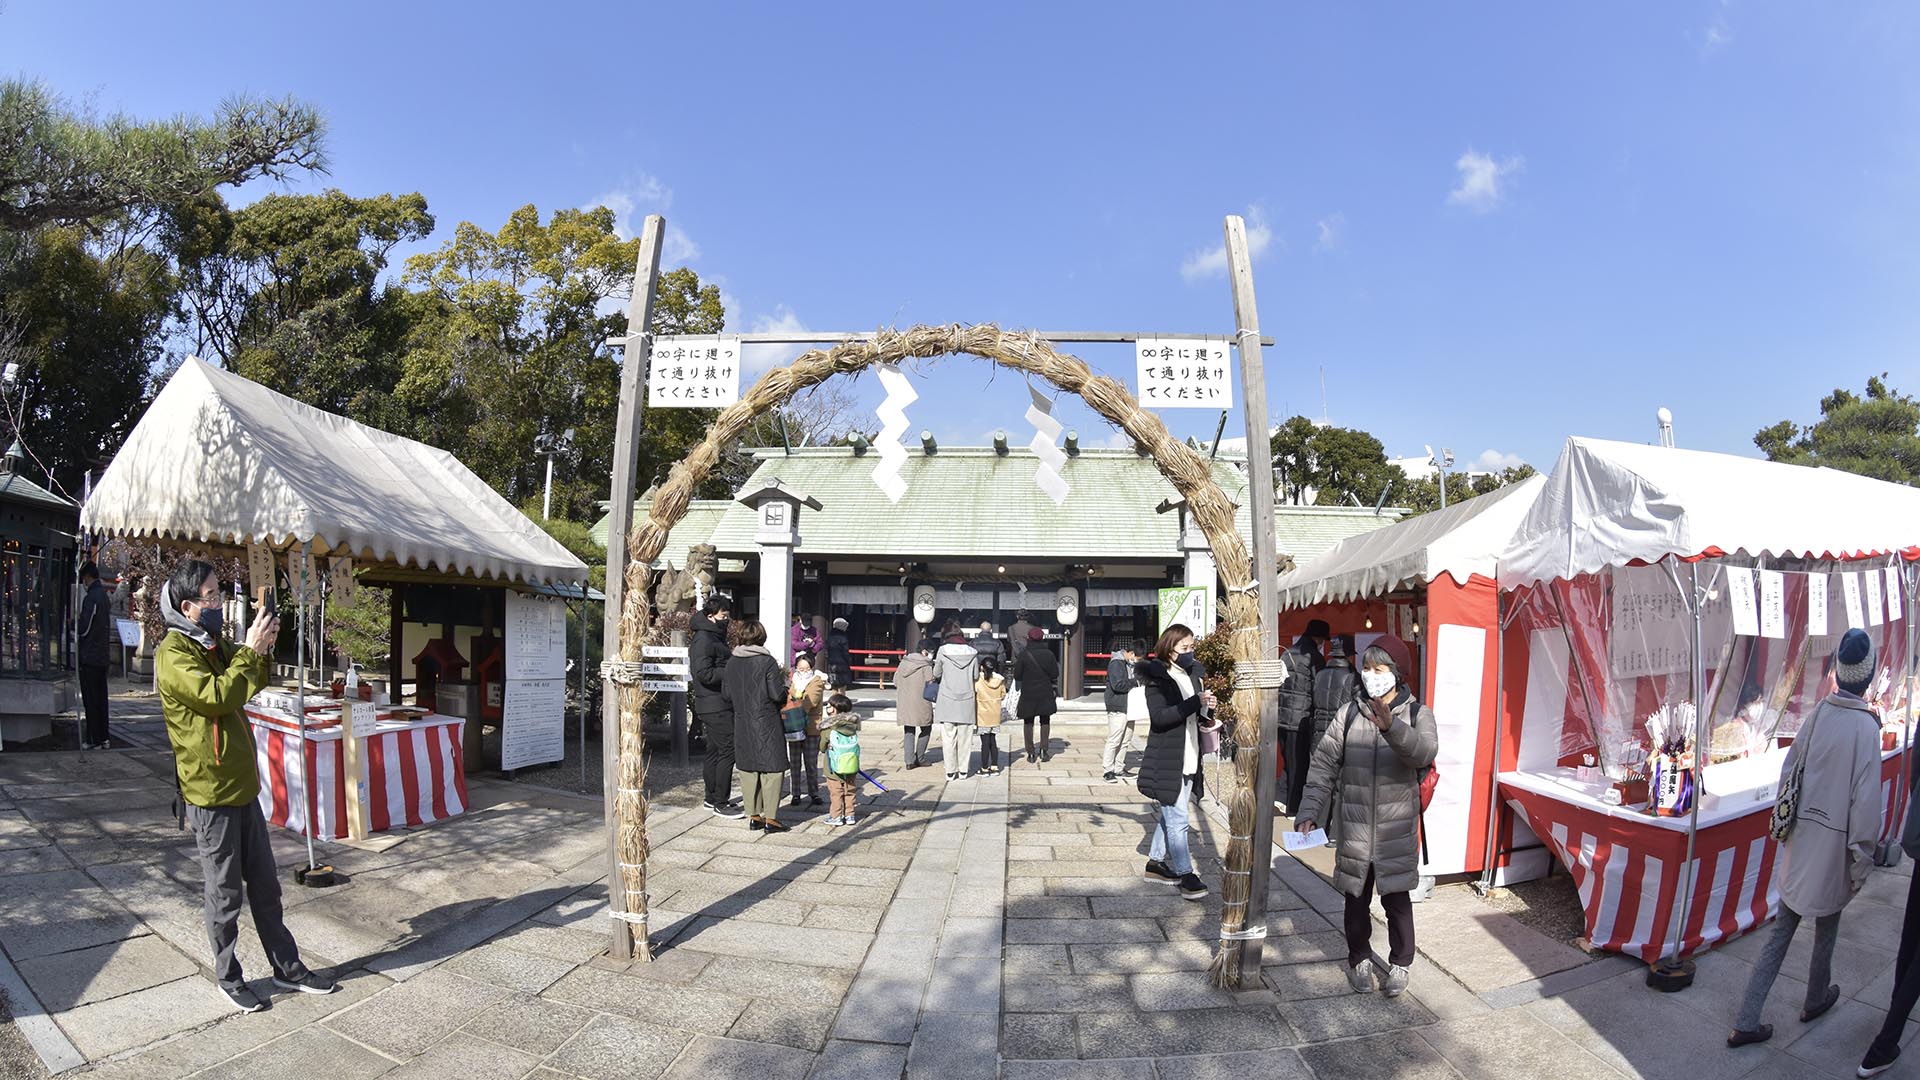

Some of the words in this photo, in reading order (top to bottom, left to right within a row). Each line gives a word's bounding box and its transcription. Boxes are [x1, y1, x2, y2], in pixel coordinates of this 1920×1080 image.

[658, 365, 732, 380] て通り抜け
[1145, 366, 1224, 380] て通り抜け
[656, 386, 726, 398] てください
[1146, 386, 1220, 399] てください
